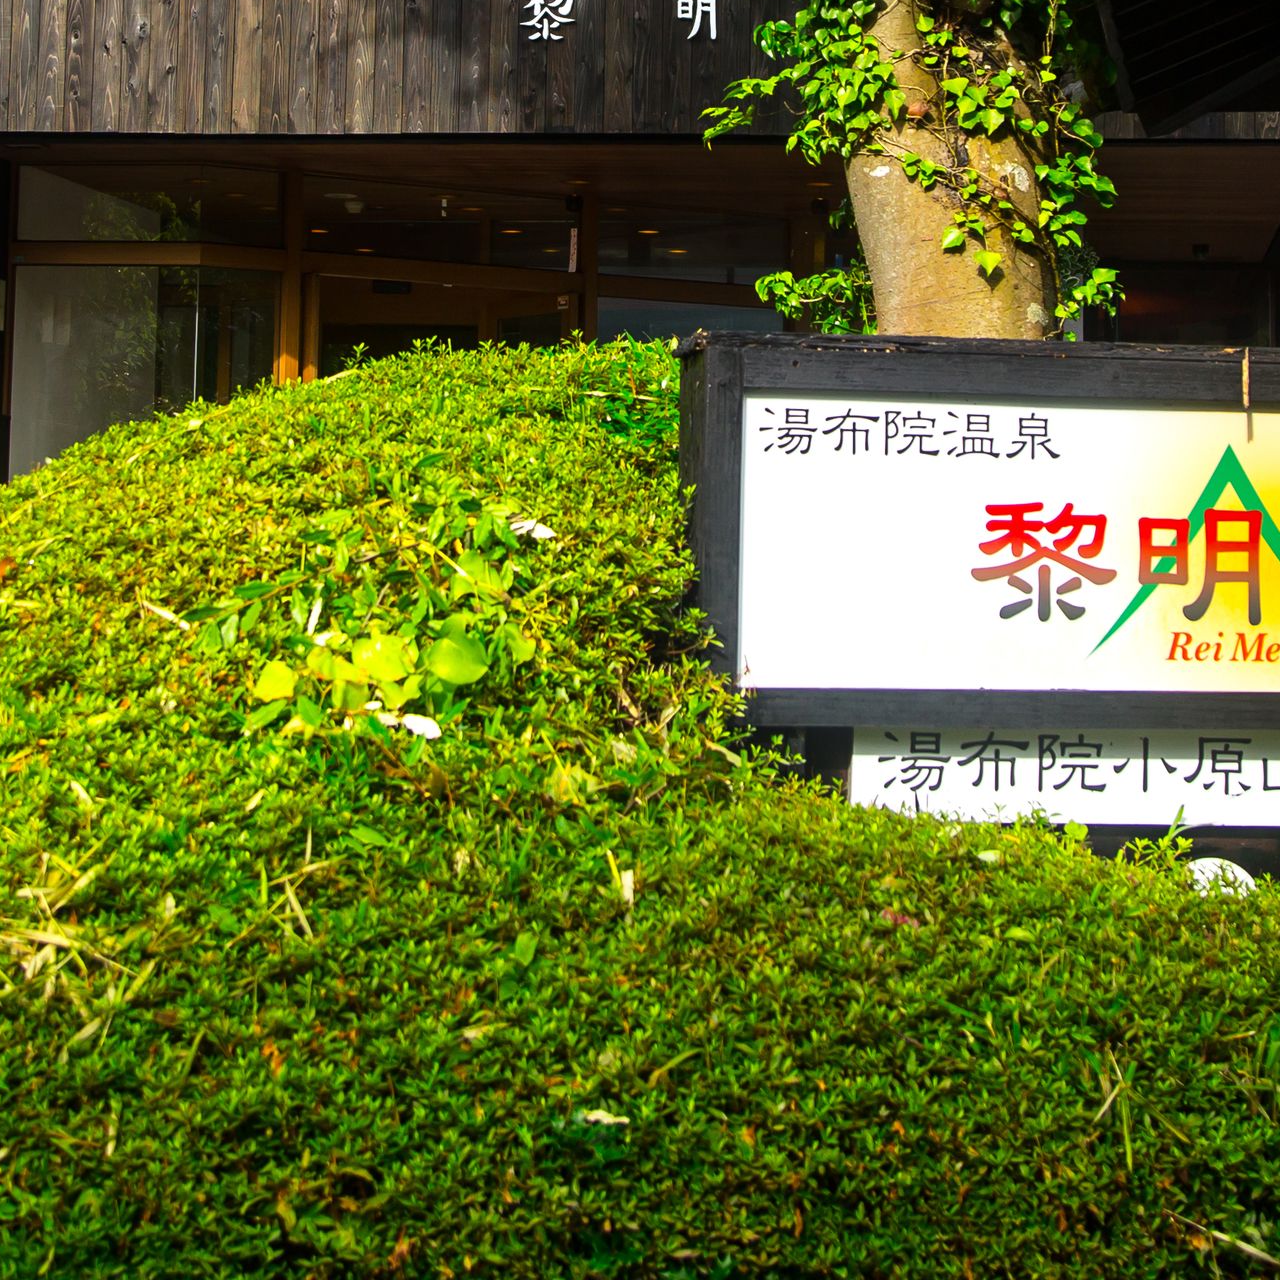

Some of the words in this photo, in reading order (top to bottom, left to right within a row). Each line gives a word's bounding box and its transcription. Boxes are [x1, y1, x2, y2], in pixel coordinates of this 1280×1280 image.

[758, 406, 1061, 461] 湯布院温泉
[971, 502, 1264, 626] 黎明
[1165, 631, 1223, 662] Rei
